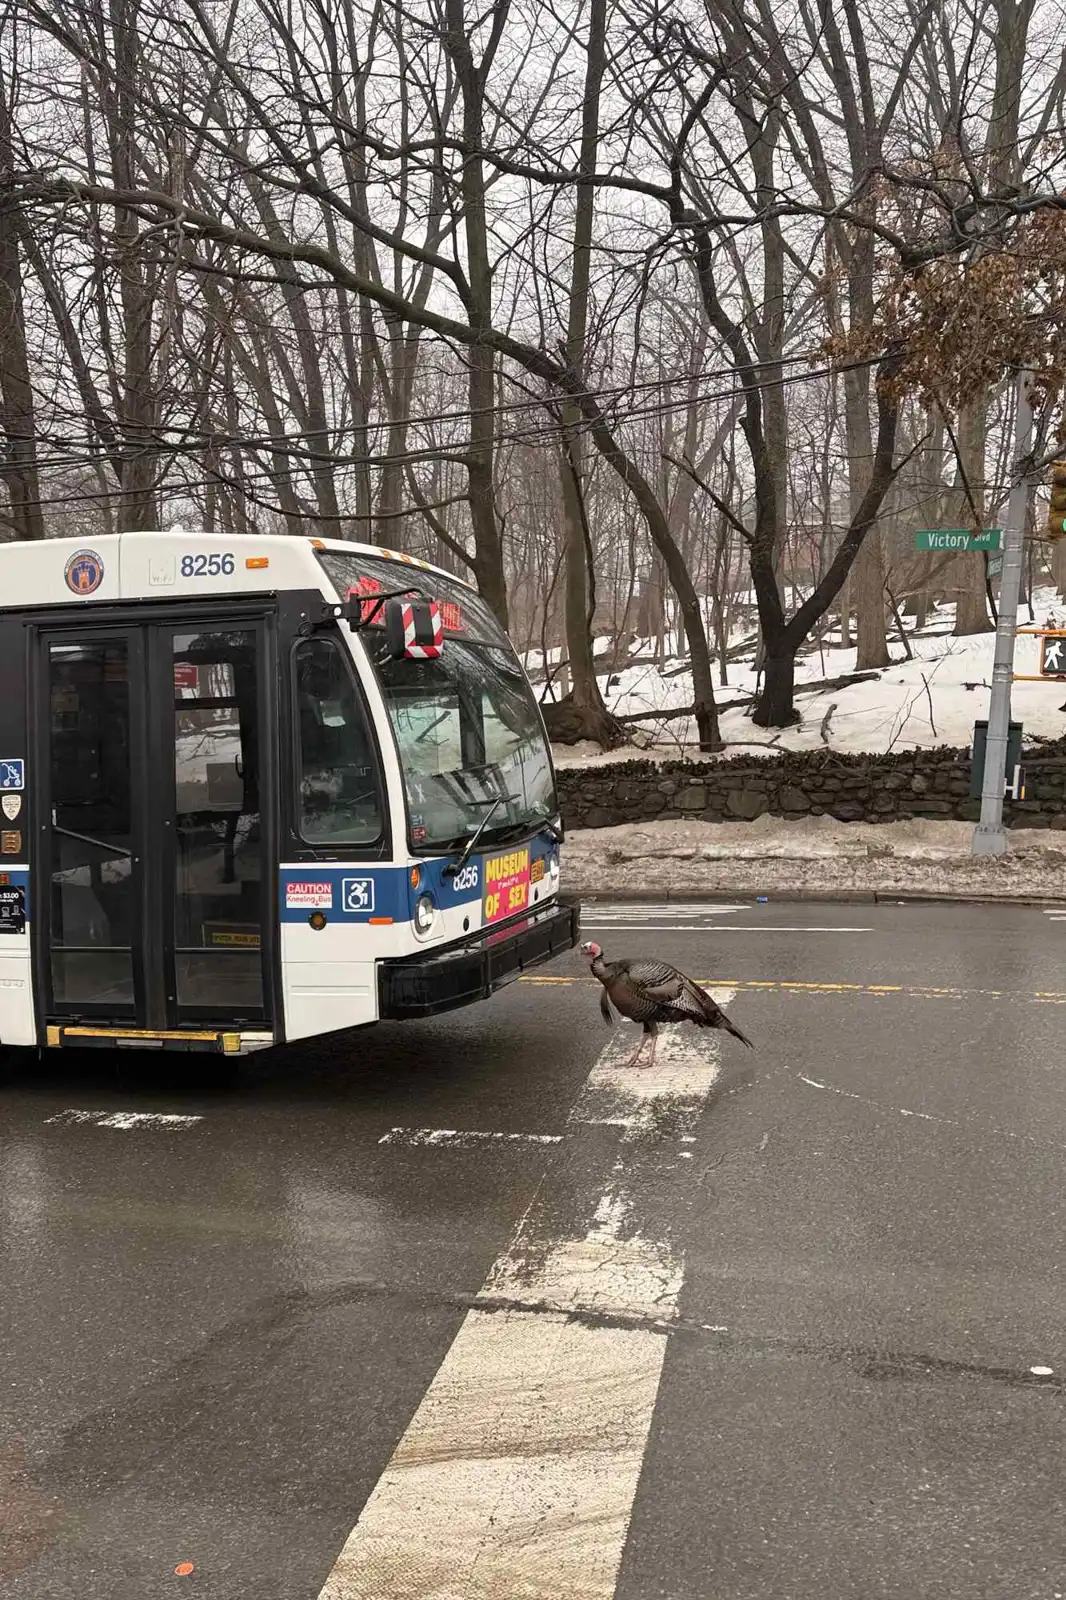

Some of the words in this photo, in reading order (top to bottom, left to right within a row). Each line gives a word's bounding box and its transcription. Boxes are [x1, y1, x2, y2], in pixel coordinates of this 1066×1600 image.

[928, 533, 969, 549] Victory
[181, 553, 235, 577] 8256
[453, 865, 478, 891] 8256
[486, 849, 528, 883] MUSEUM
[287, 883, 332, 894] CAUTION
[287, 895, 316, 904] Kneeling
[318, 895, 332, 904] Bus
[486, 893, 500, 919] OF
[509, 883, 527, 909] SEX
